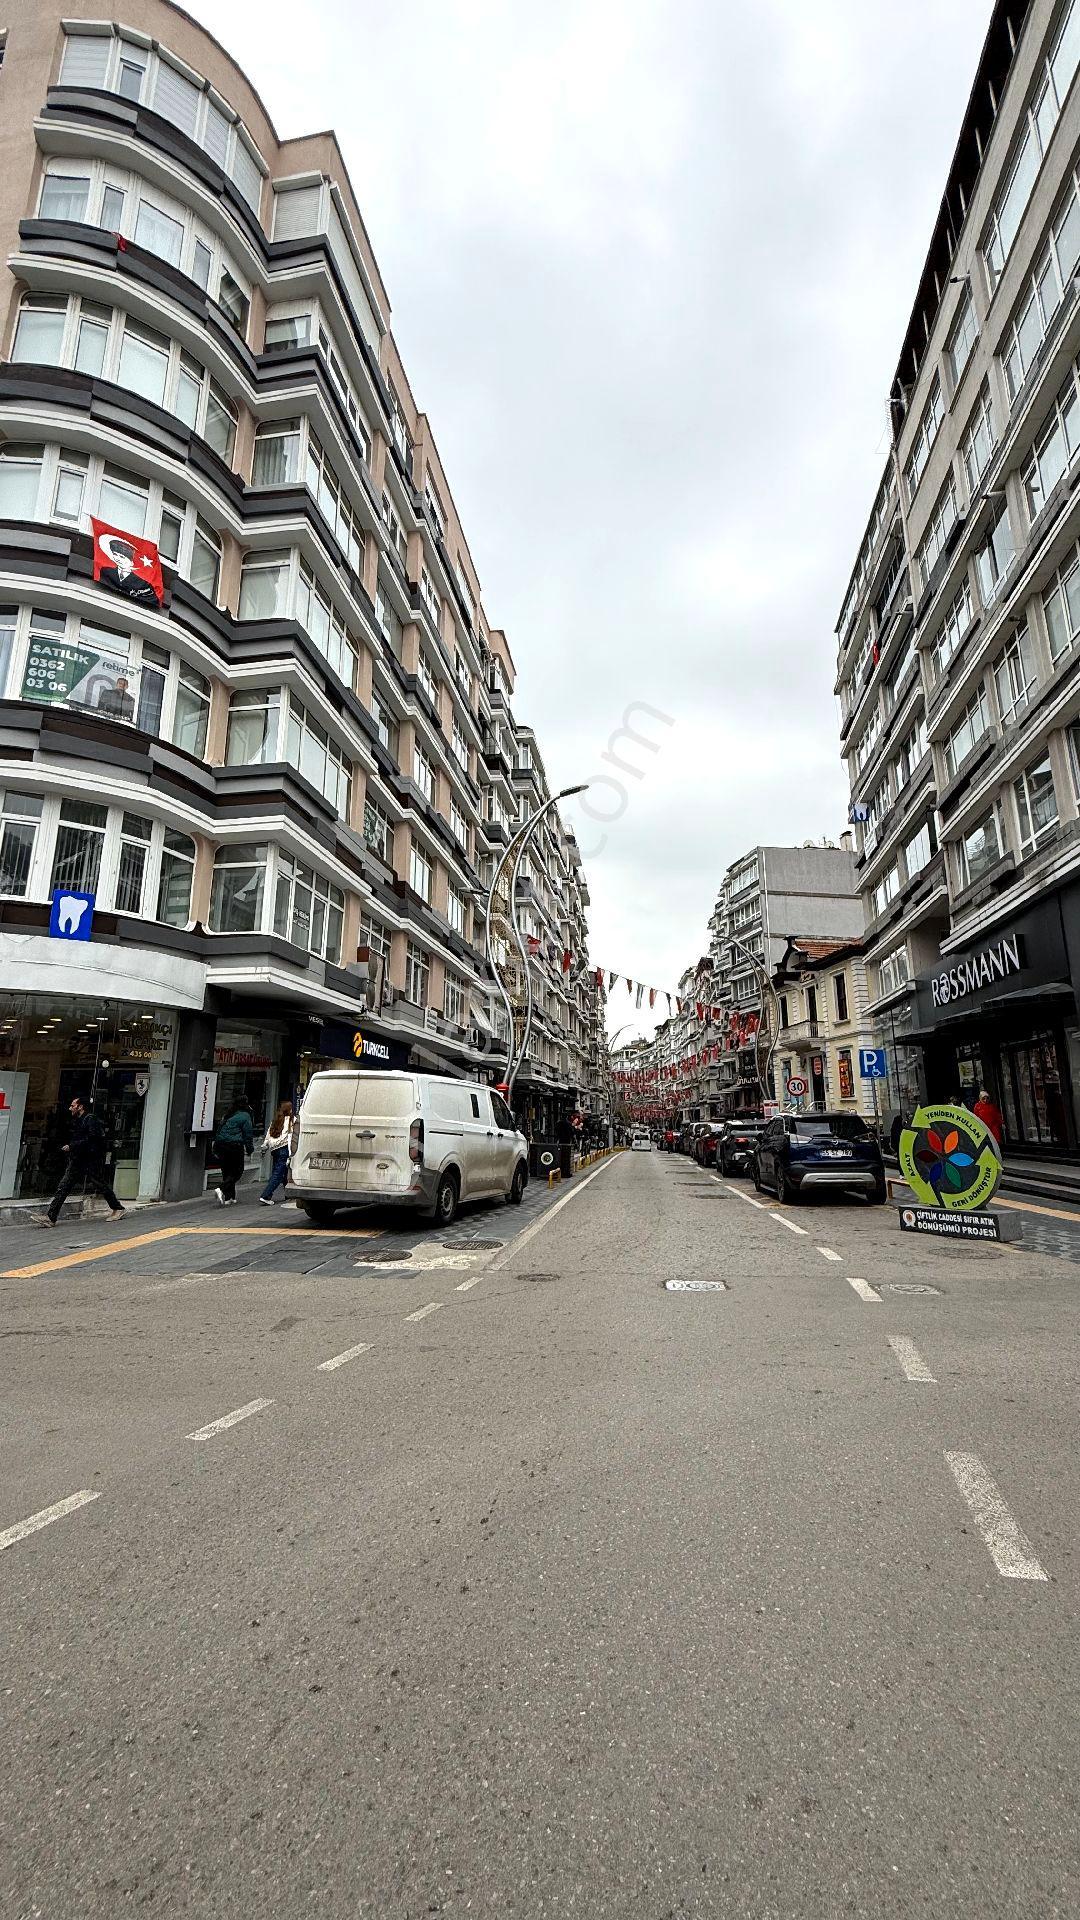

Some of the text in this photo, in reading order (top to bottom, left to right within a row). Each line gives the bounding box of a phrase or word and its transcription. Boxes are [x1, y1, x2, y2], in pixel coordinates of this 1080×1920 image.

[32, 644, 90, 665] SATILIK
[29, 657, 66, 671] 0362
[28, 667, 56, 680] 606
[26, 678, 67, 692] 03 06
[932, 933, 1020, 1008] ROSSMANN
[362, 1040, 390, 1059] TURKCELL
[863, 1051, 877, 1073] P
[790, 1082, 803, 1092] 30
[200, 1076, 210, 1128] VESTEL
[925, 1110, 982, 1139] YENİDEN KULLAN
[904, 1153, 916, 1177] AZALT
[951, 1196, 969, 1208] GERİ
[938, 1212, 963, 1223] CADDESİ
[917, 1222, 997, 1238] DÖNÜŞÜMÜ PROJESİ
